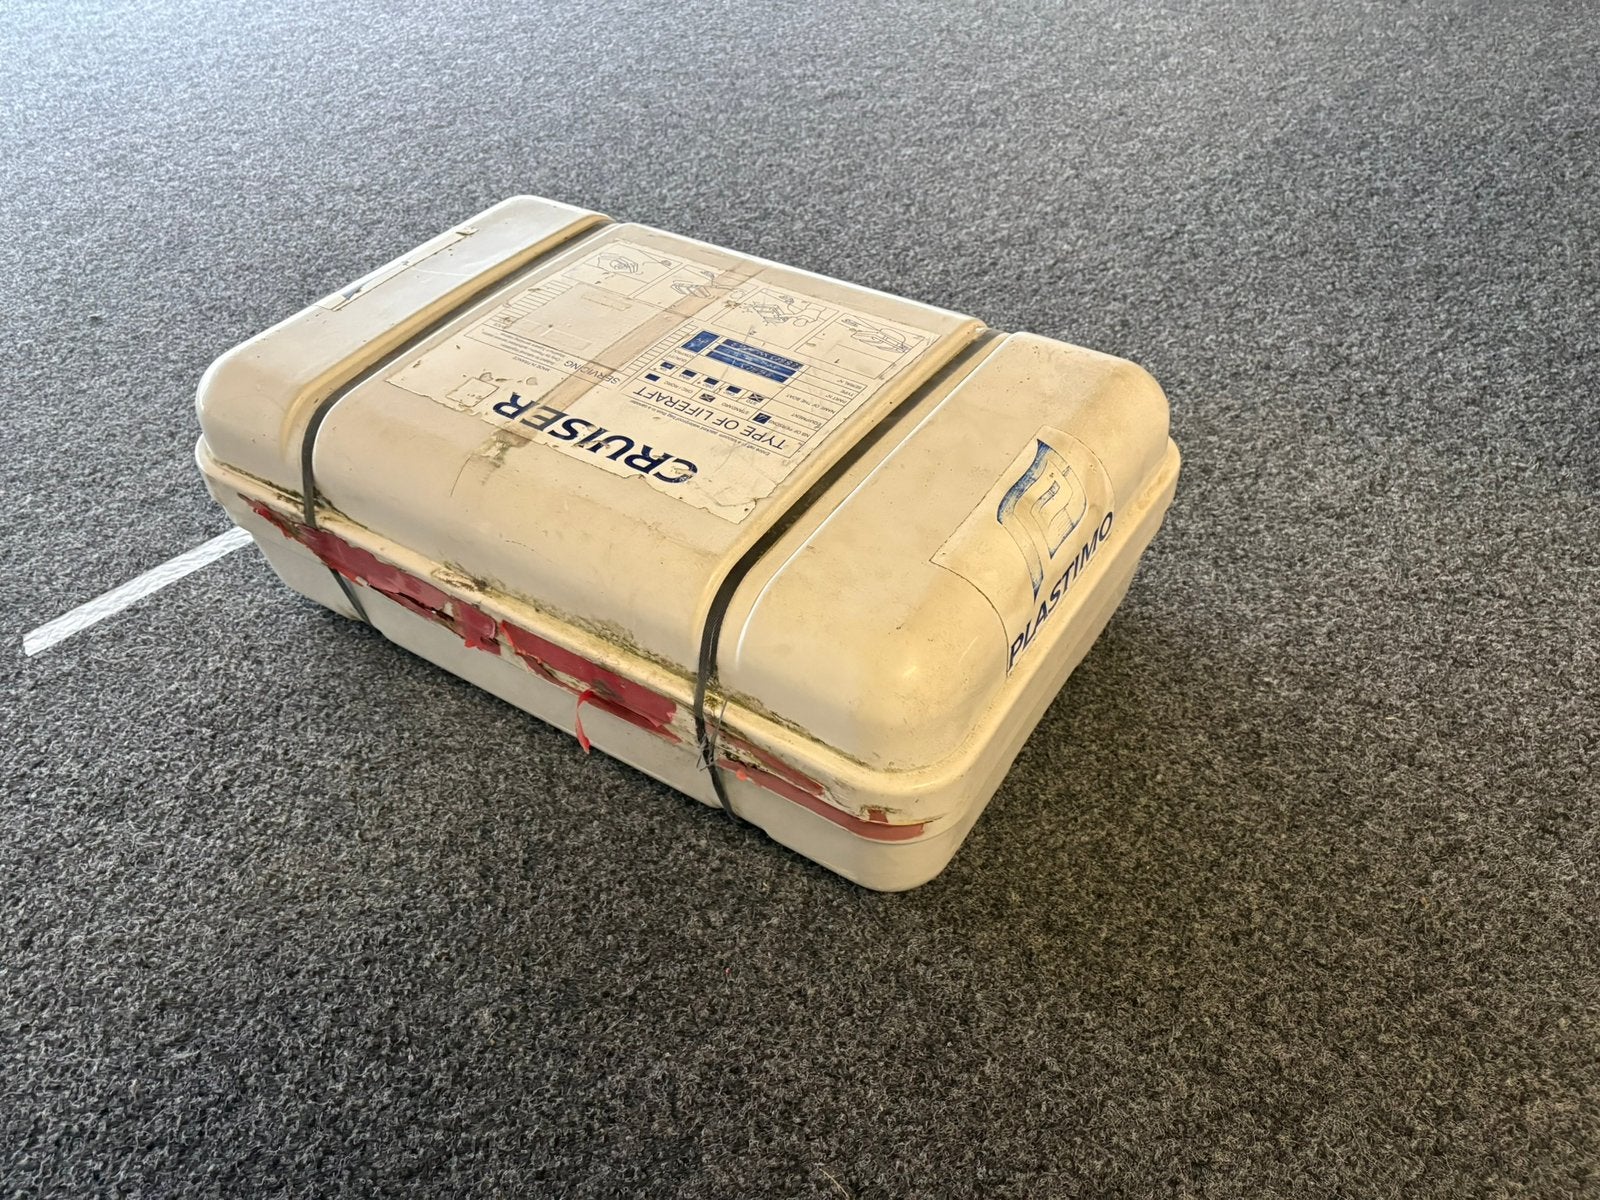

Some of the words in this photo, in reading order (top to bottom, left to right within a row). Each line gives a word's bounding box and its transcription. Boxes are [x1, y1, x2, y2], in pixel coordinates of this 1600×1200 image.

[564, 360, 620, 384] SERVICING
[633, 387, 714, 420] LIFERAFT
[820, 406, 835, 414] NAME
[712, 418, 739, 430] OF
[493, 392, 697, 483] CRUISER
[740, 425, 786, 450] TYPE
[1008, 511, 1113, 667] PLASTIMO
